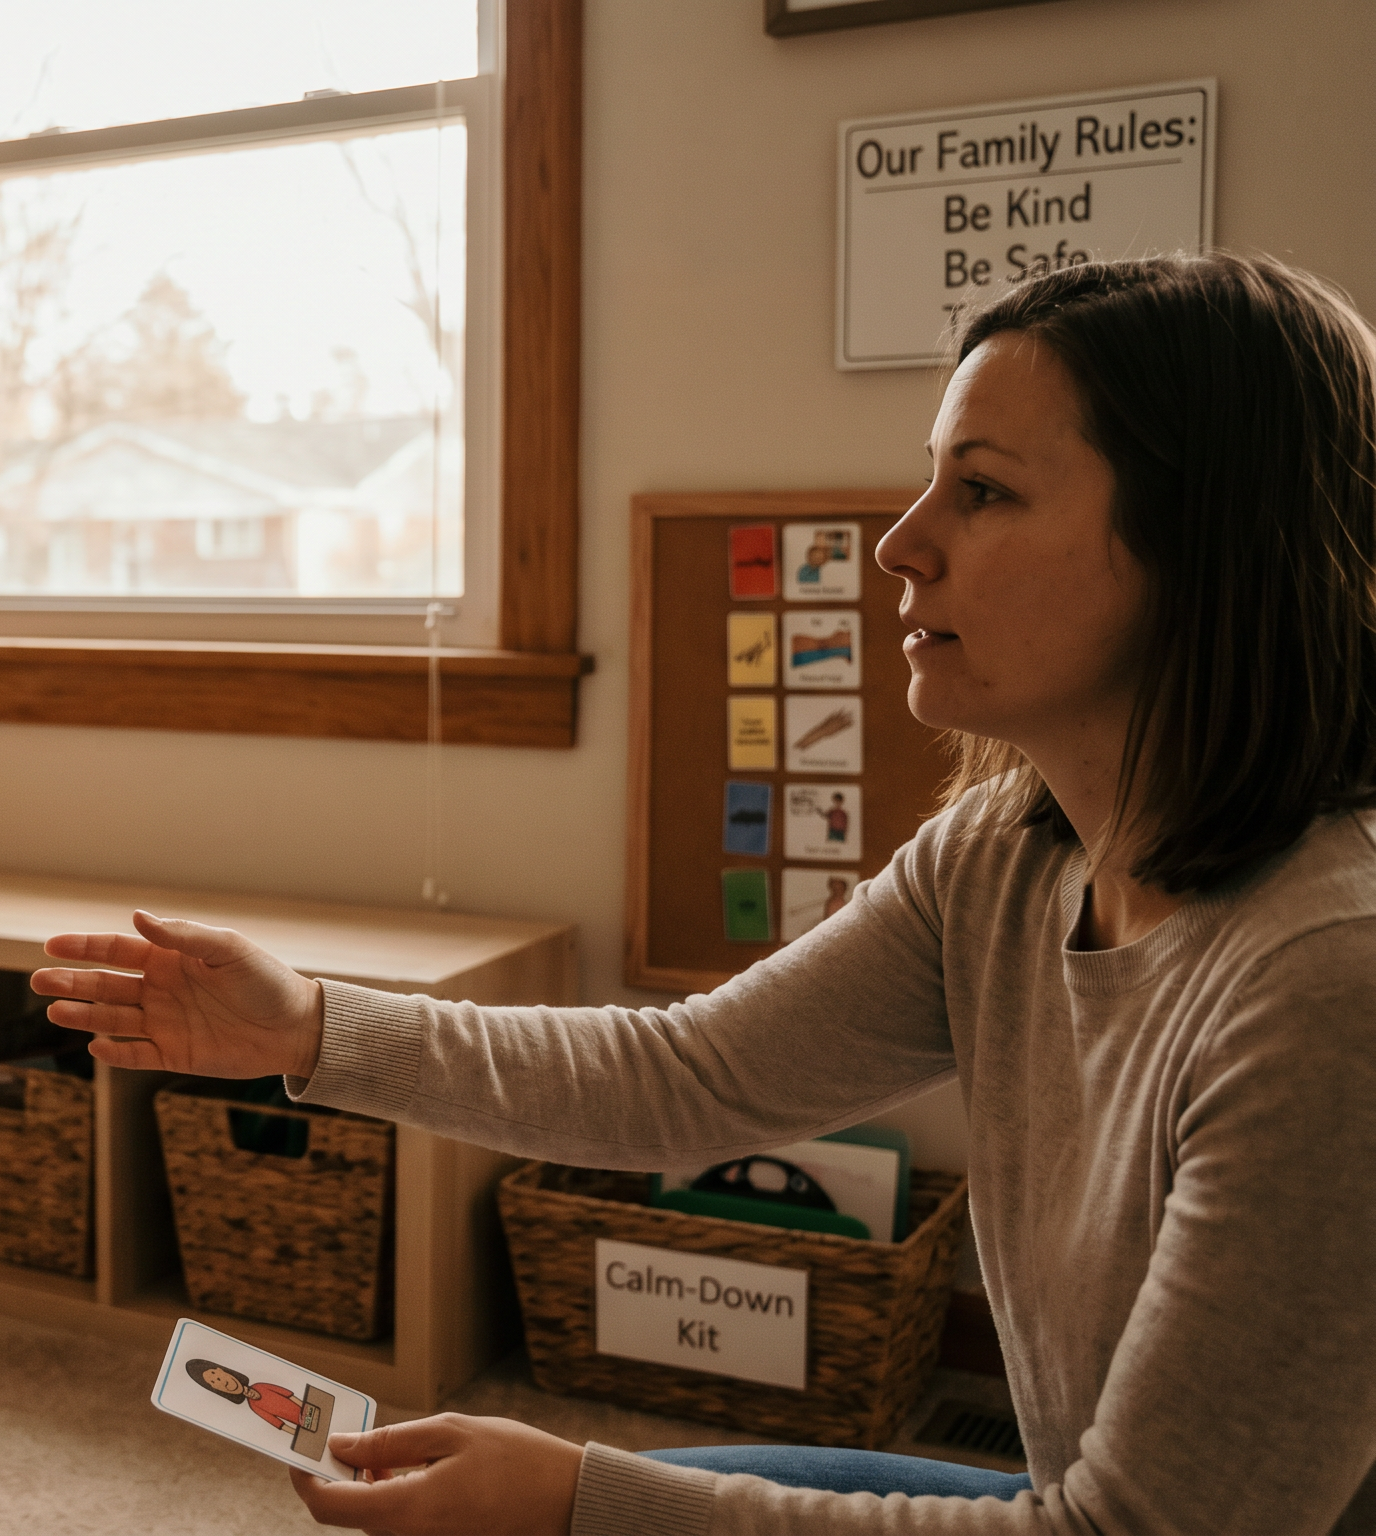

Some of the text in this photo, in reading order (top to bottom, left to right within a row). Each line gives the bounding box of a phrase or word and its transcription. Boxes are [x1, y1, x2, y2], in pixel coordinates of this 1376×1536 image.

[856, 110, 1196, 178] Our Family Rules:
[944, 182, 1091, 233] Be Kind
[944, 248, 992, 288] Be
[606, 1260, 794, 1318] Calm-Down
[677, 1318, 720, 1353] Kit
